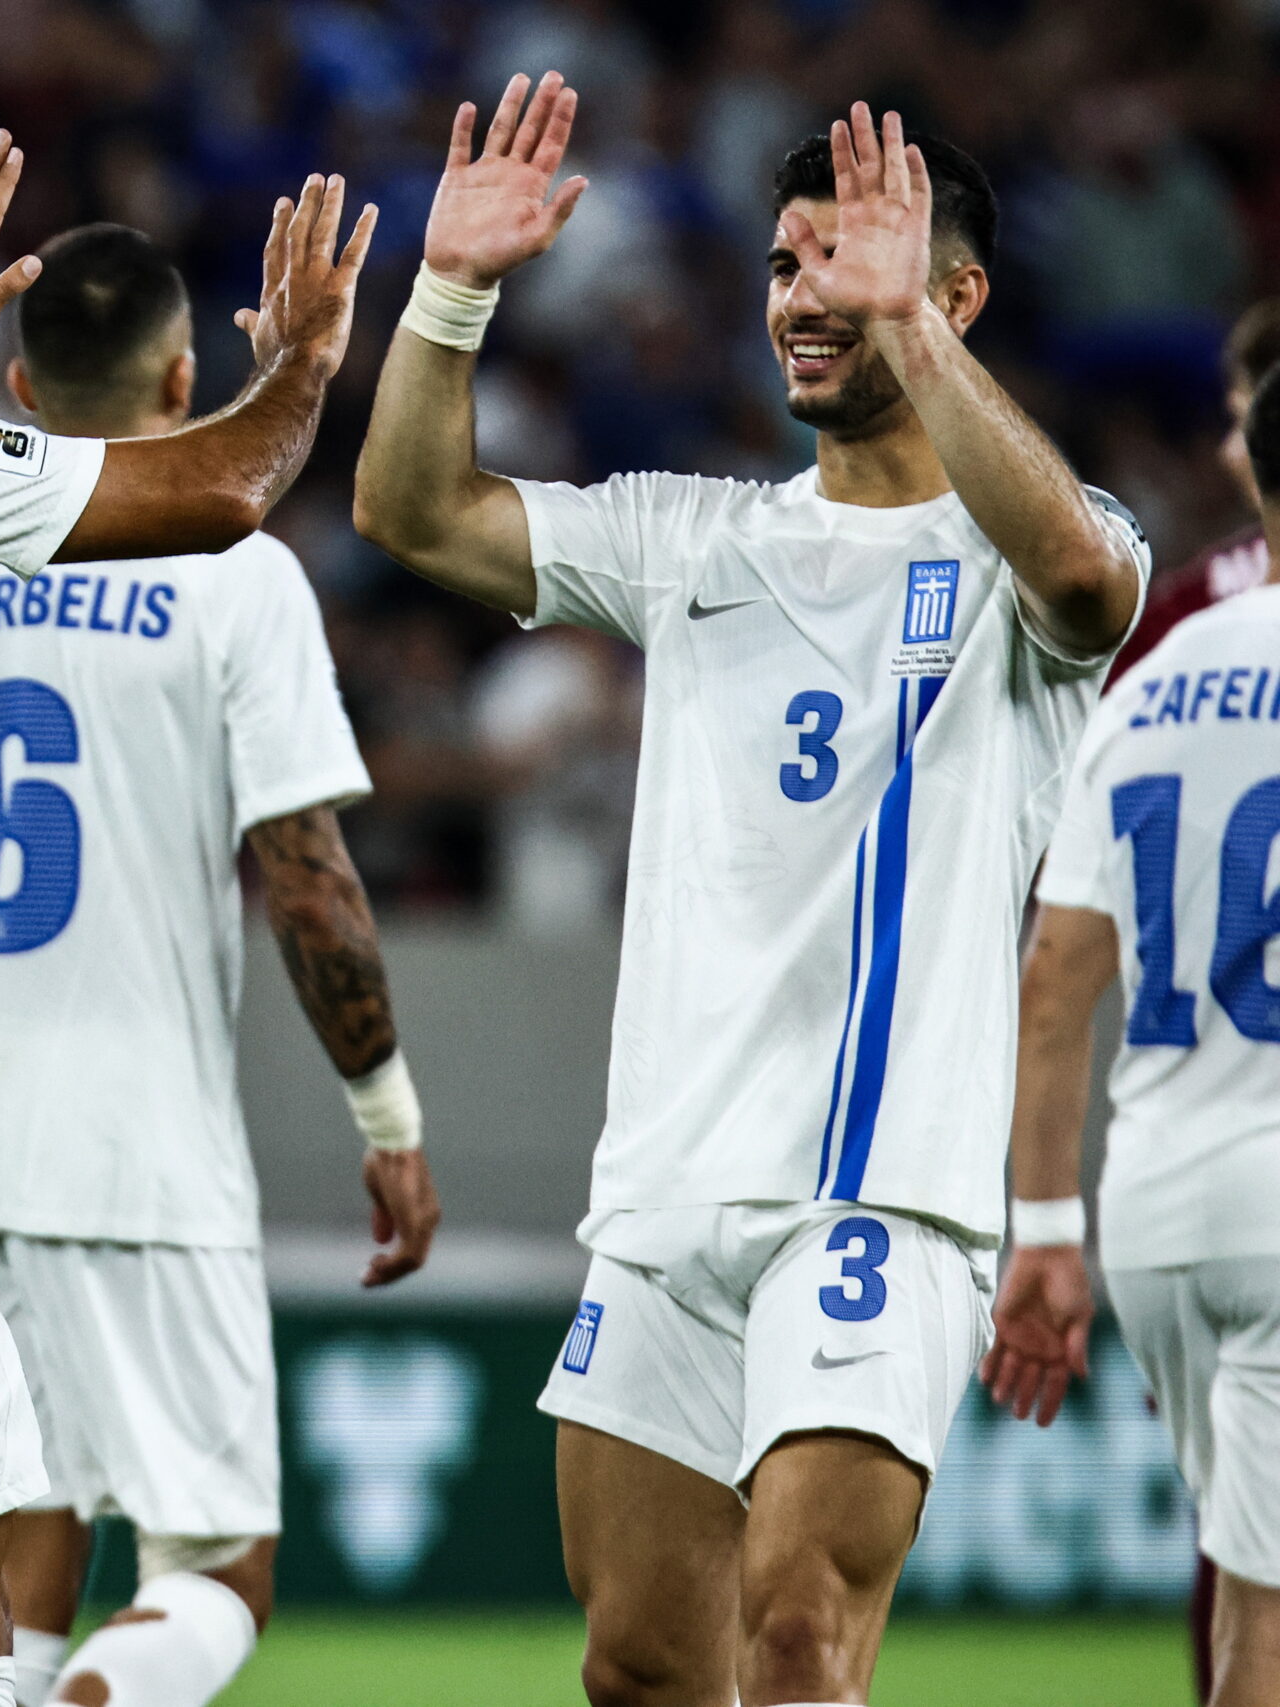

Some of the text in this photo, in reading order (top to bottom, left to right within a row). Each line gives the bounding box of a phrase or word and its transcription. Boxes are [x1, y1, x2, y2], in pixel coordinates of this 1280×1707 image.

[915, 566, 952, 578] ΕΛΛΑΣ
[780, 690, 843, 802] 3
[818, 1216, 890, 1321] 3
